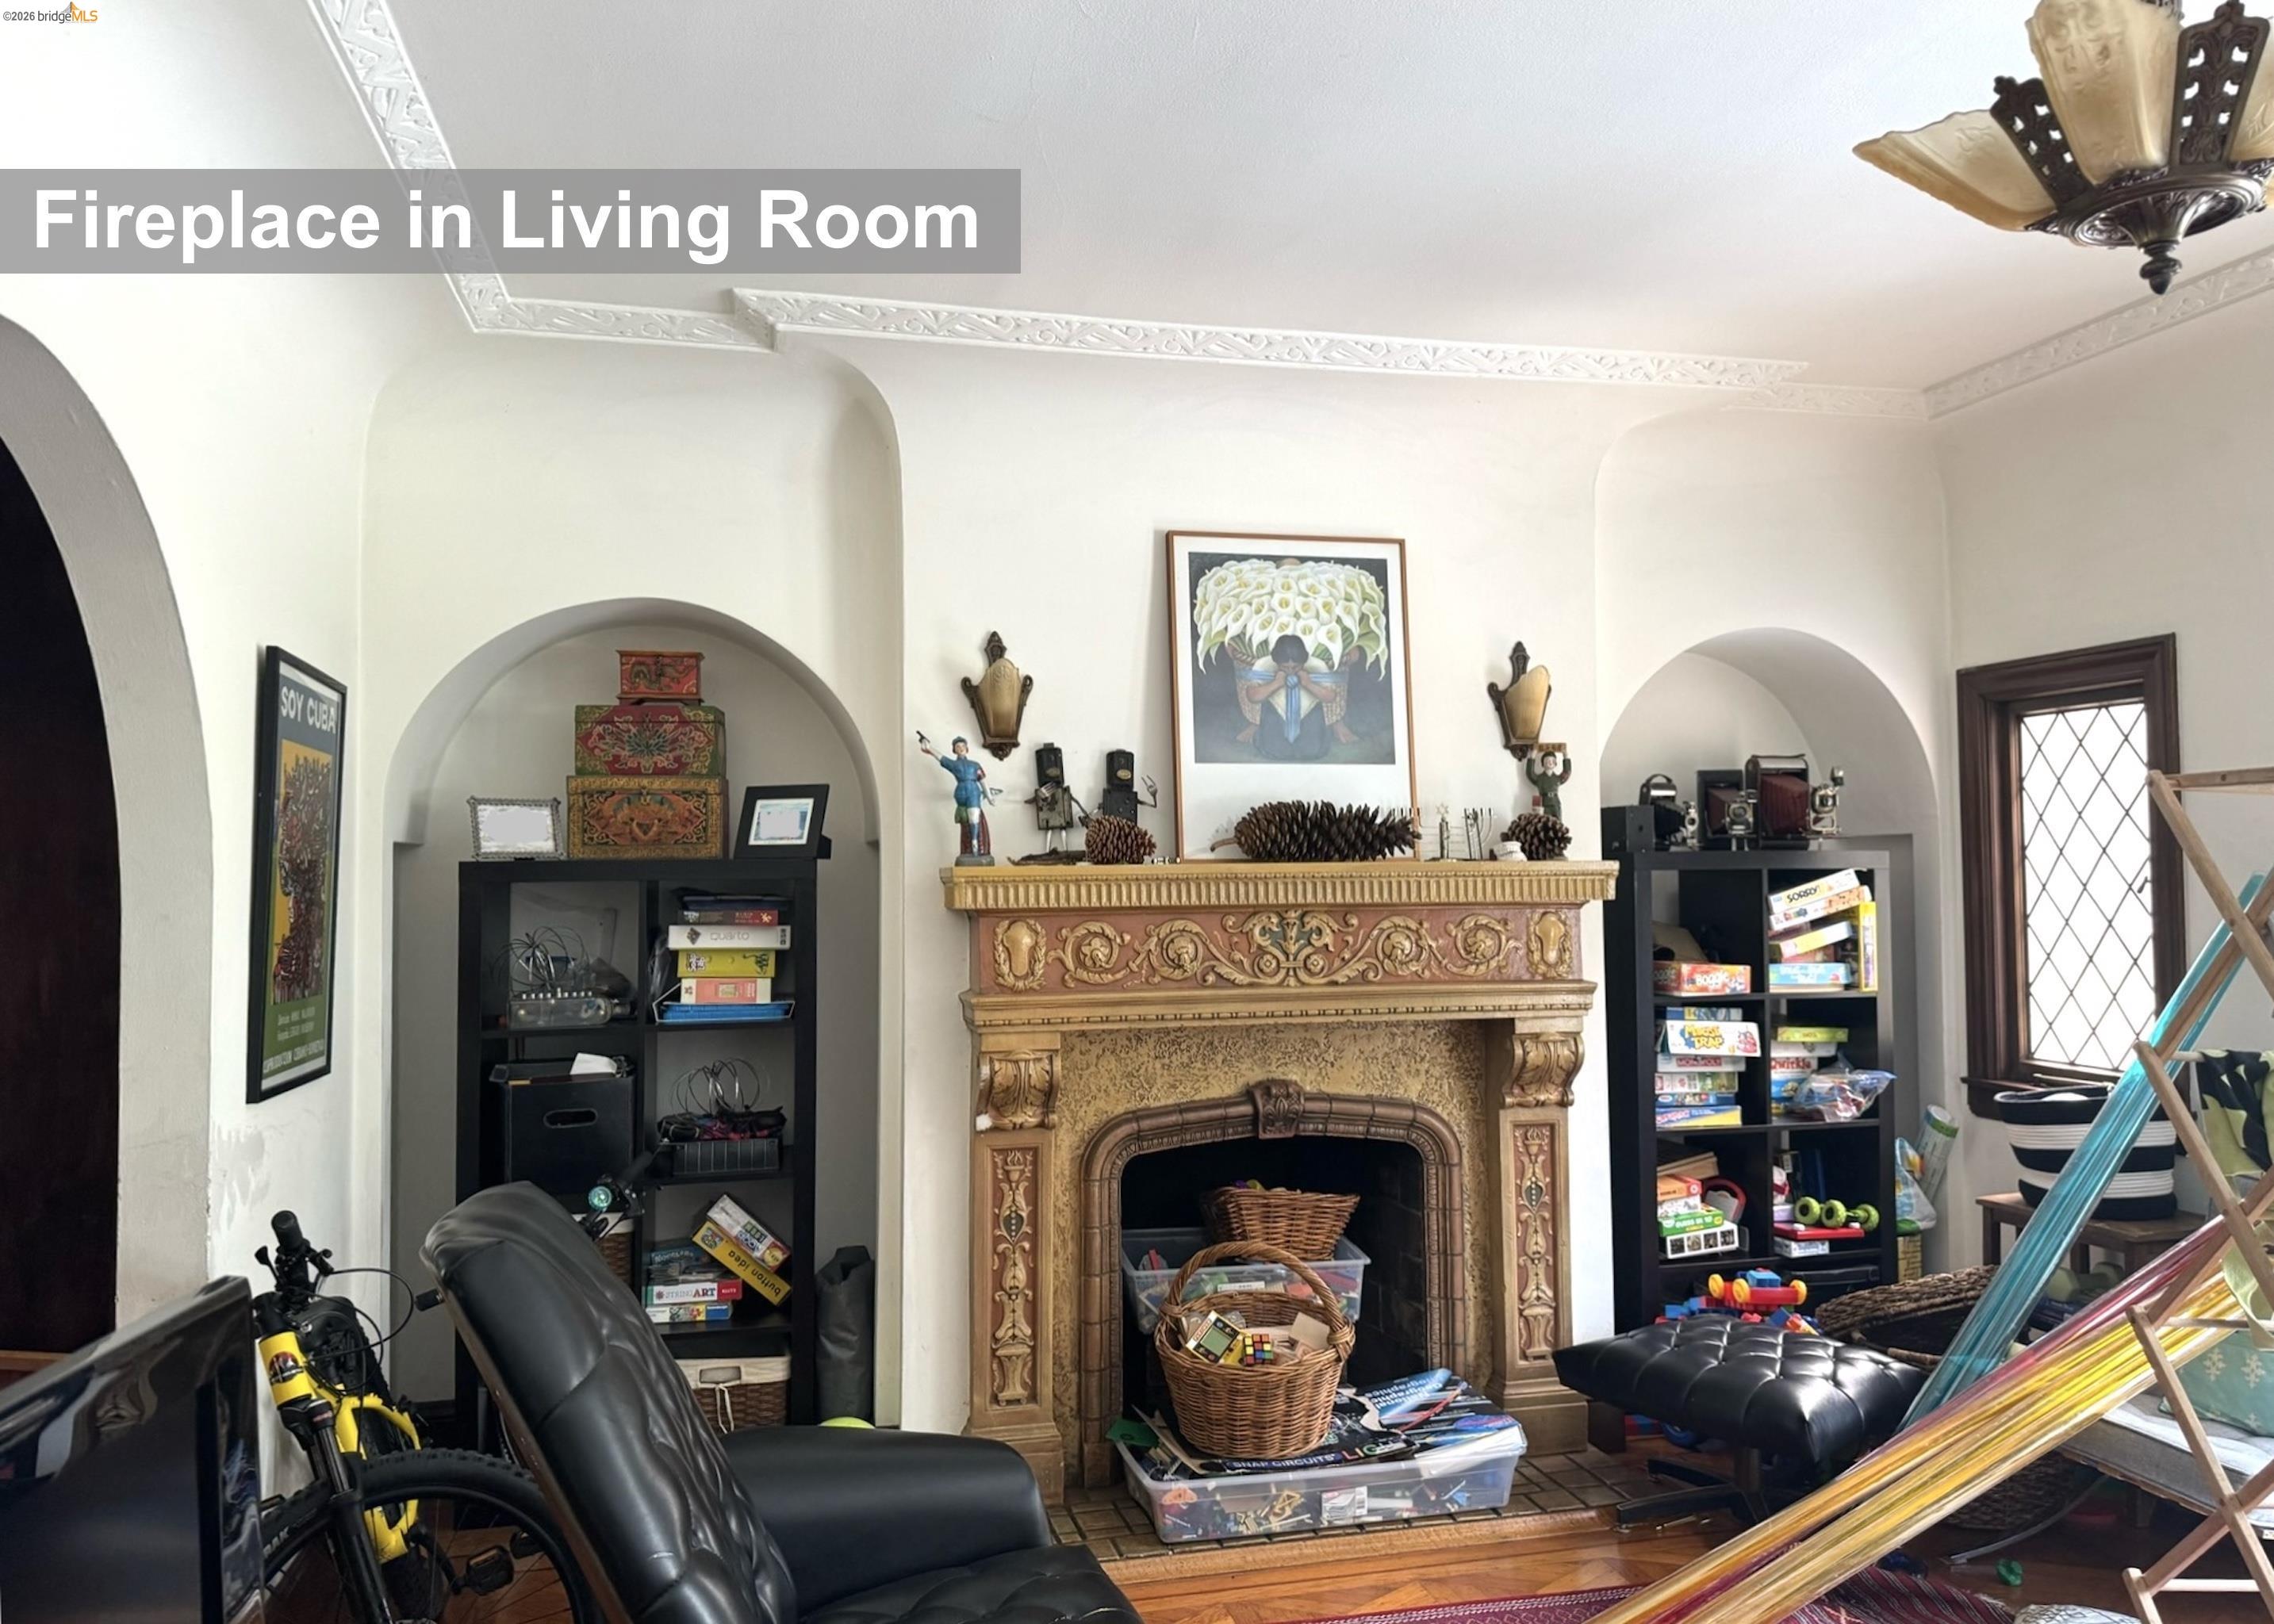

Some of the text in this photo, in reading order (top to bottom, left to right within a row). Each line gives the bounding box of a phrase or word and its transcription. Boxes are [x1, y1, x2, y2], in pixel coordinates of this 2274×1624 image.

[281, 685, 336, 734] SOY CUBA
[728, 1250, 750, 1272] idea
[692, 1287, 716, 1299] ART
[750, 1269, 781, 1297] button
[1231, 1456, 1269, 1468] SNAP
